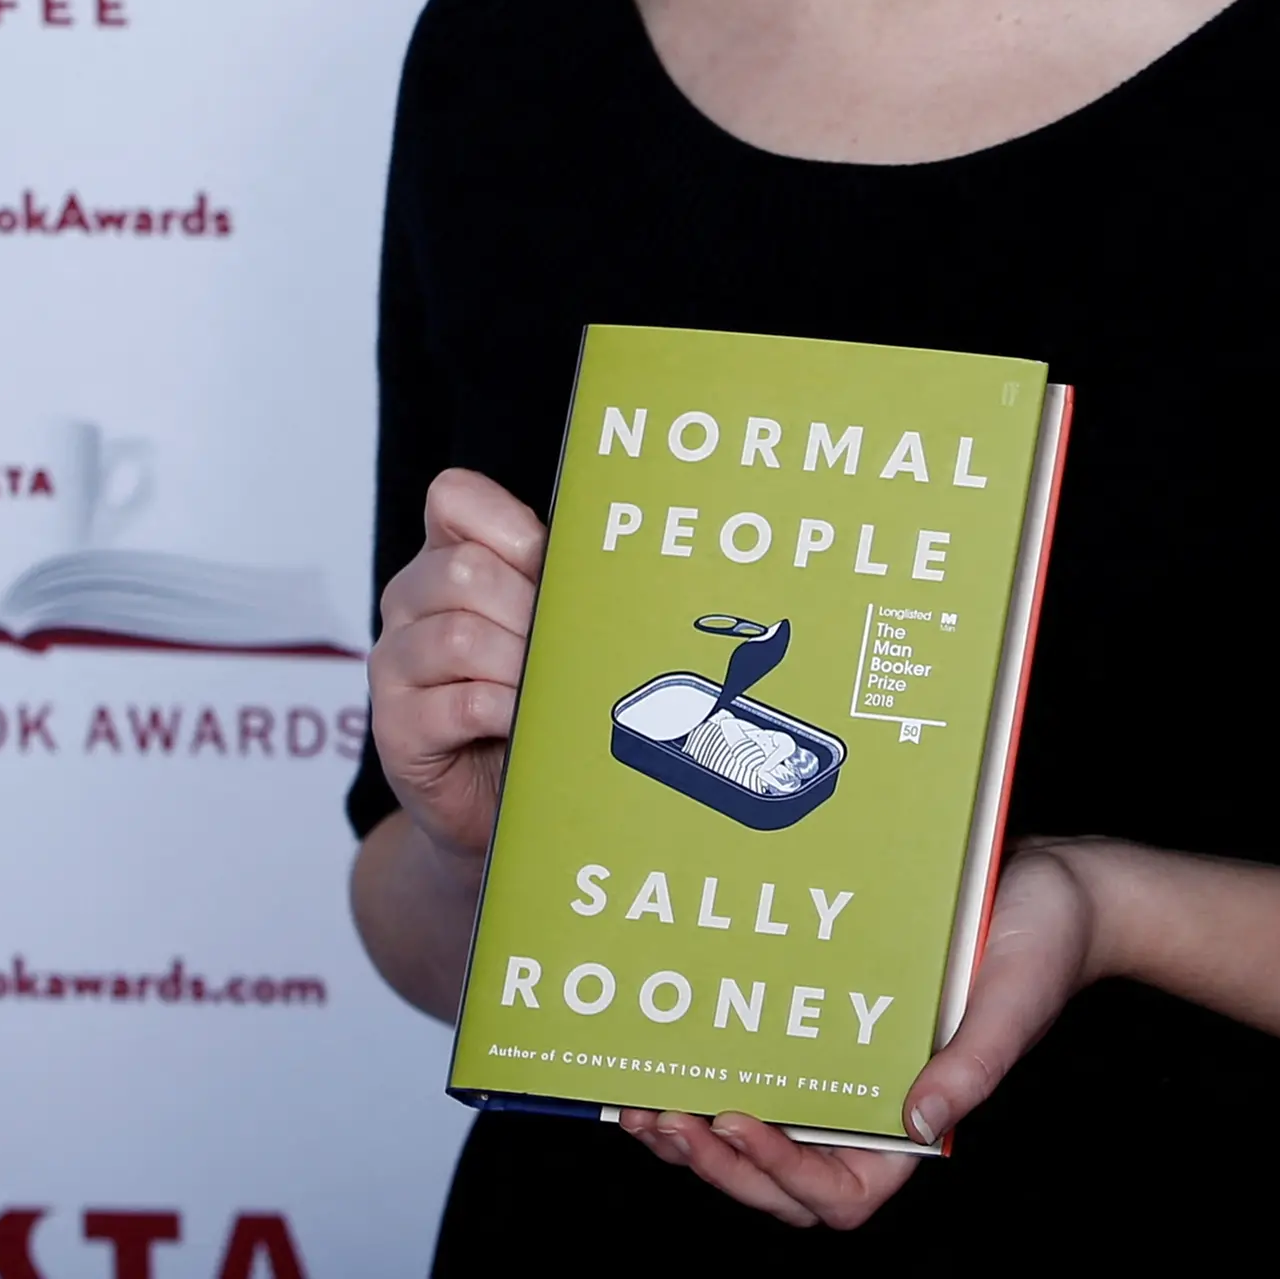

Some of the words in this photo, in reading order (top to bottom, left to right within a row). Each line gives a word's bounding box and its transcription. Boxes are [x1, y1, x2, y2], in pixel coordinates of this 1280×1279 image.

[599, 407, 987, 488] NORMAL
[603, 503, 950, 581] PEOPLE
[878, 606, 933, 621] Longlisted
[876, 622, 907, 640] The
[873, 639, 913, 659] Man
[870, 656, 932, 677] Booker
[867, 673, 907, 692] Prize
[863, 692, 894, 708] 2018
[85, 703, 366, 762] AWARDS
[902, 725, 919, 738] 50
[571, 864, 854, 940] SALLY
[500, 956, 894, 1045] ROONEY
[488, 1044, 537, 1059] Author
[540, 1049, 556, 1061] of
[562, 1051, 728, 1081] CONVERSATIONS
[738, 1070, 787, 1087] WITH
[797, 1077, 880, 1098] FRIENDS
